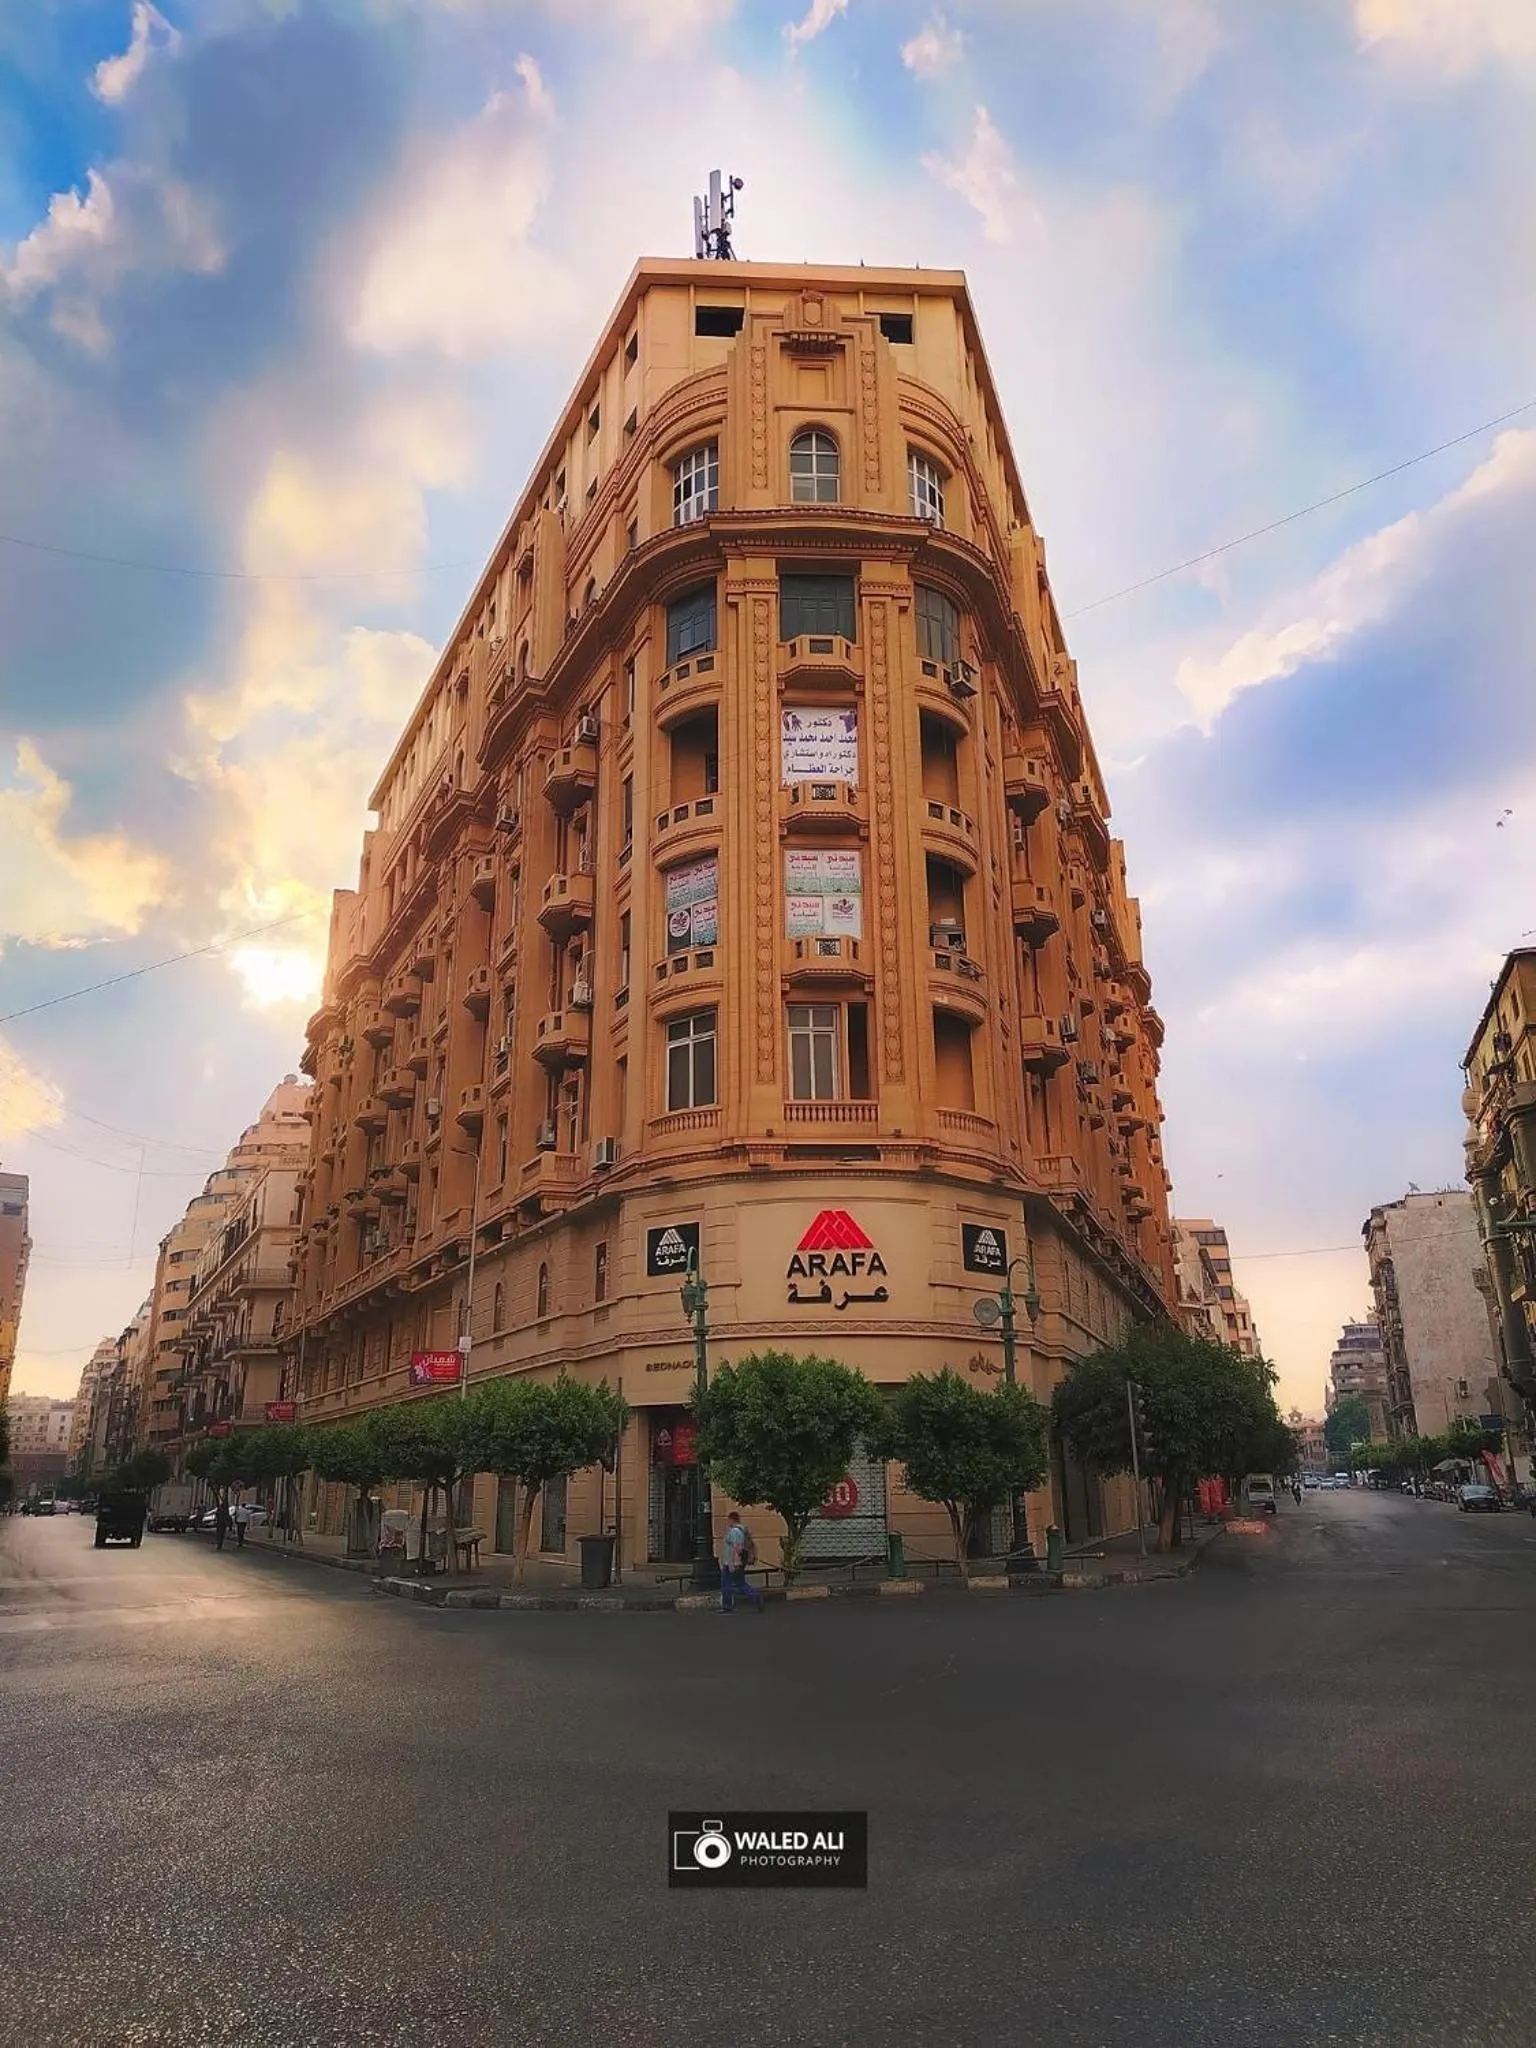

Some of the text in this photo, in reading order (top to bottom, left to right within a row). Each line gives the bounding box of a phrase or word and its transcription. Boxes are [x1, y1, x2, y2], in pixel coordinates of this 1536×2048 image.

[807, 717, 832, 728] دكتور
[655, 1243, 687, 1256] ARAFA
[973, 1244, 1001, 1257] ARAFA
[786, 1252, 888, 1279] ARAFA
[787, 1280, 890, 1311] عرفة
